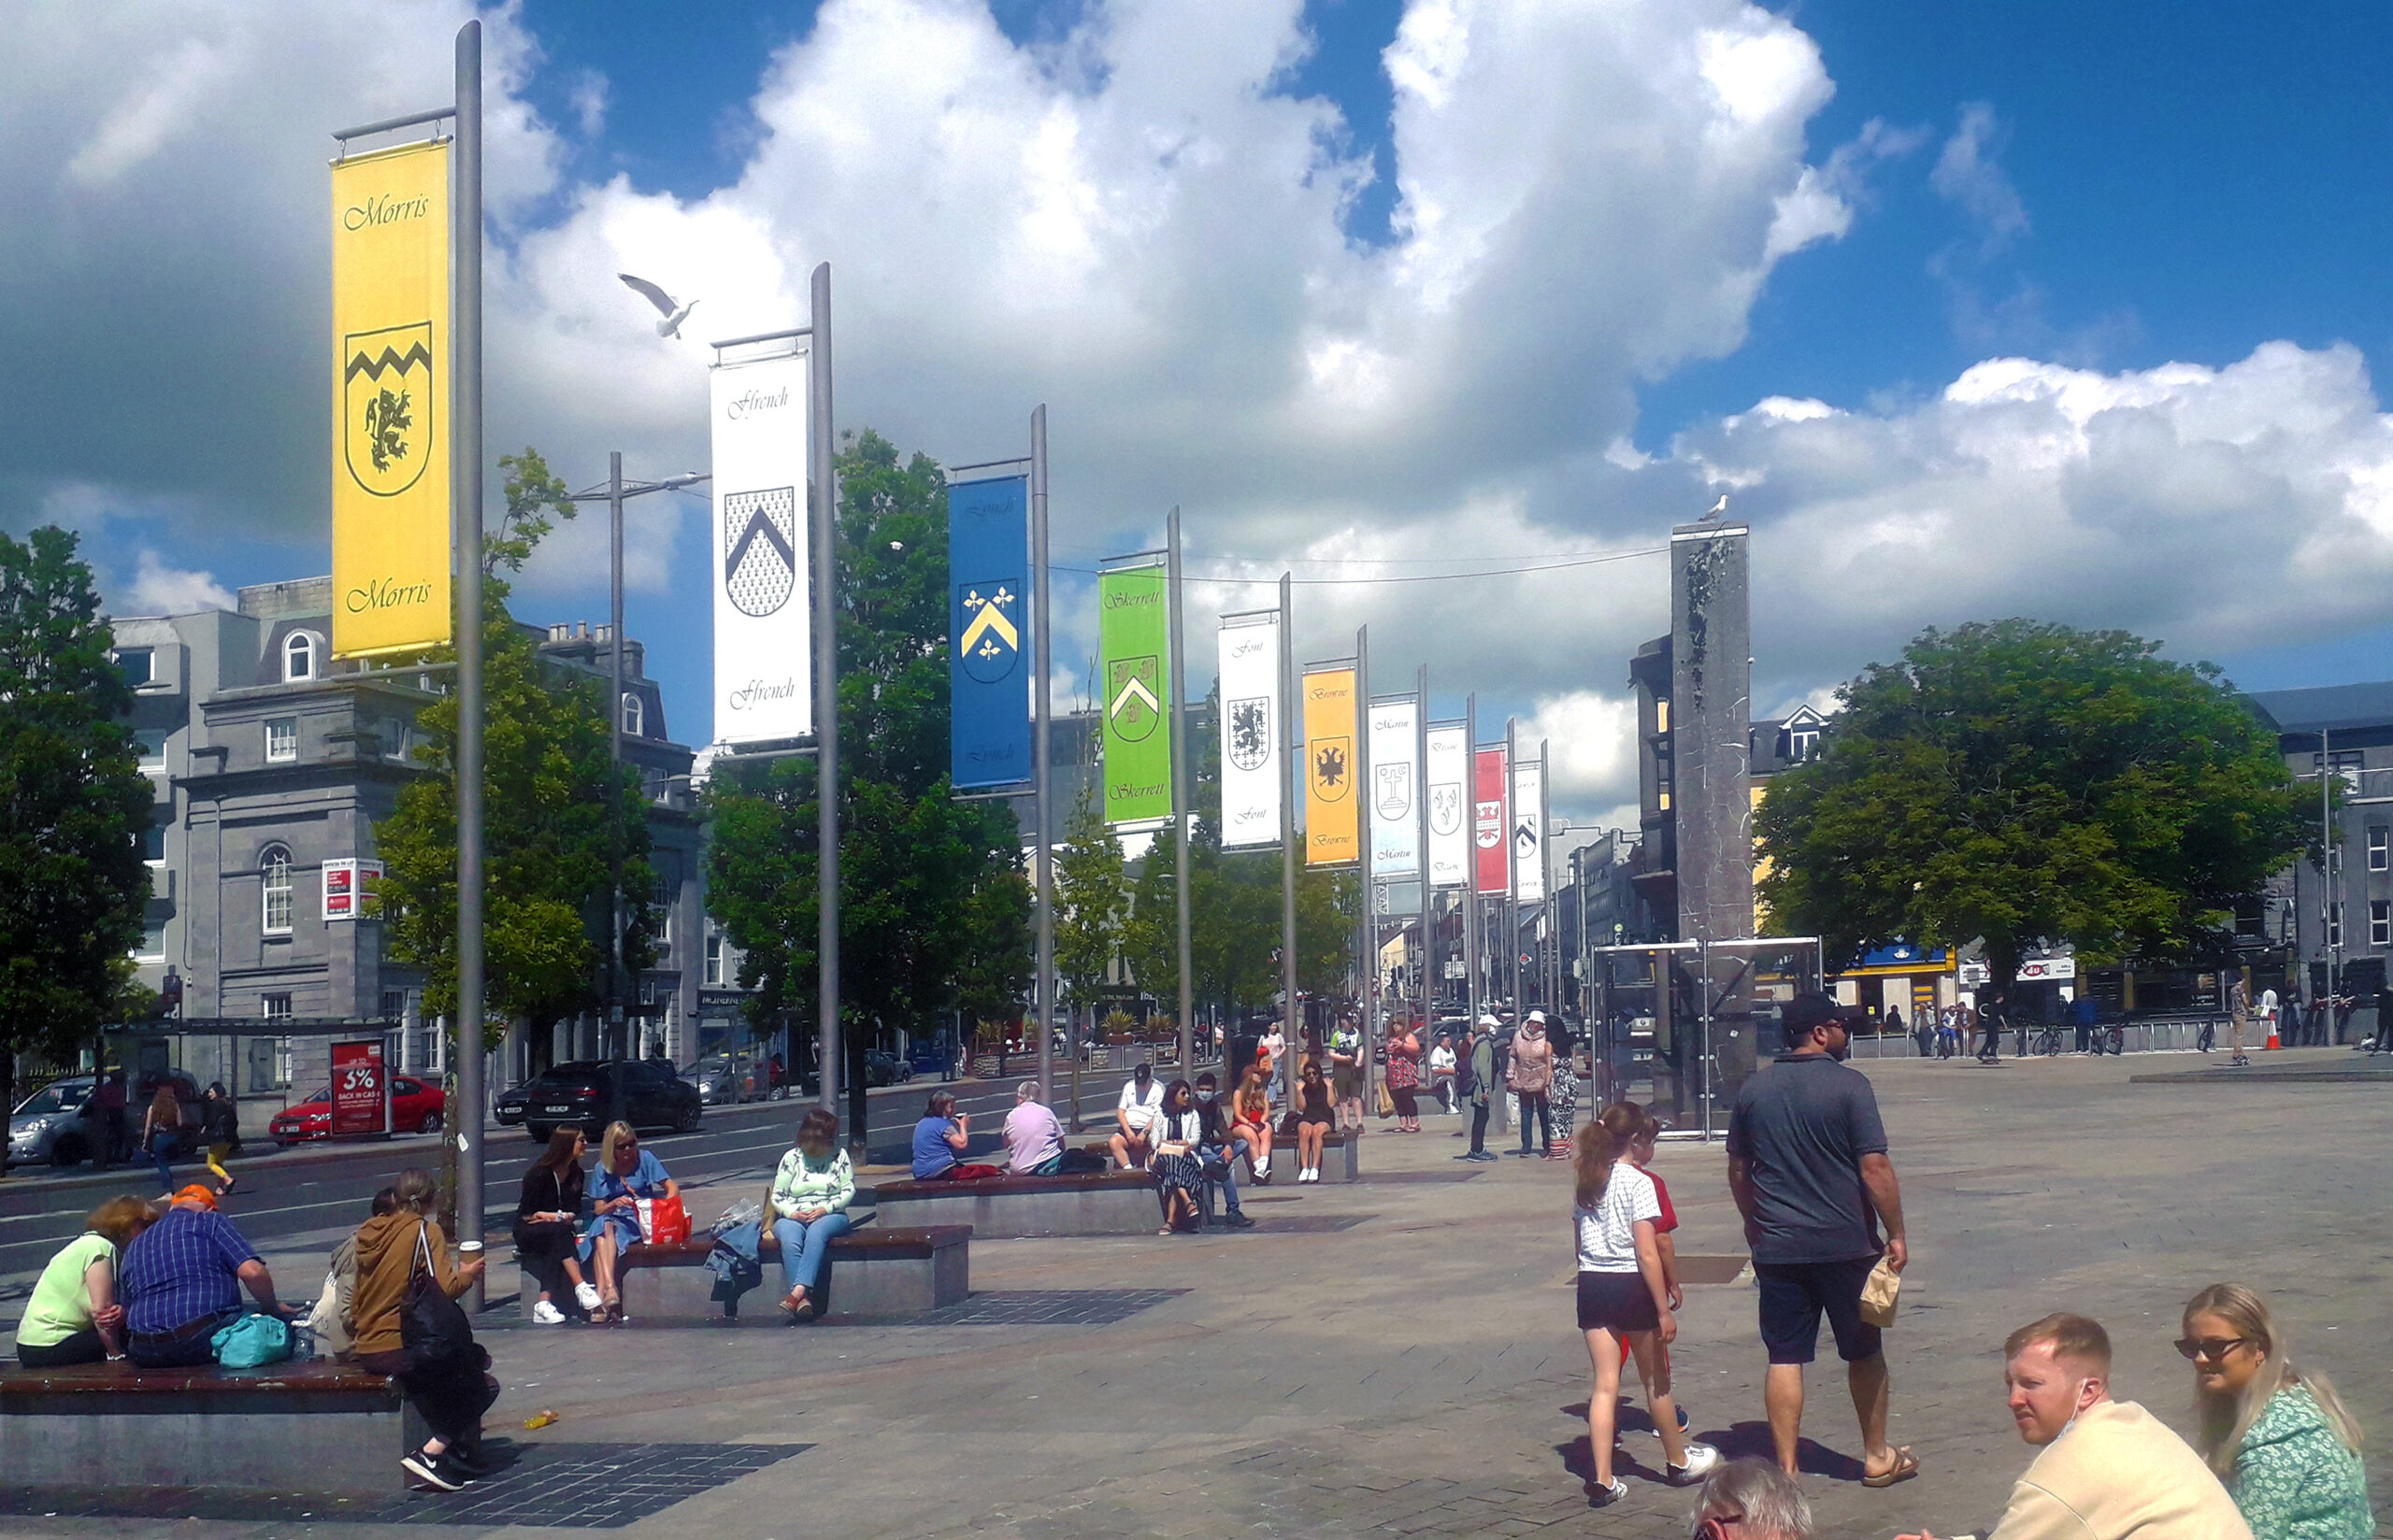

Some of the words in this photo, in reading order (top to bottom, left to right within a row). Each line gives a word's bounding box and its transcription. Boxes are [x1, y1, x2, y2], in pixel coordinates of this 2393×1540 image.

[344, 192, 429, 231] Morris
[728, 386, 788, 420] Ffrench
[347, 577, 431, 613] Morris
[730, 676, 795, 710] Ffrench
[1109, 783, 1165, 800] Skerrett
